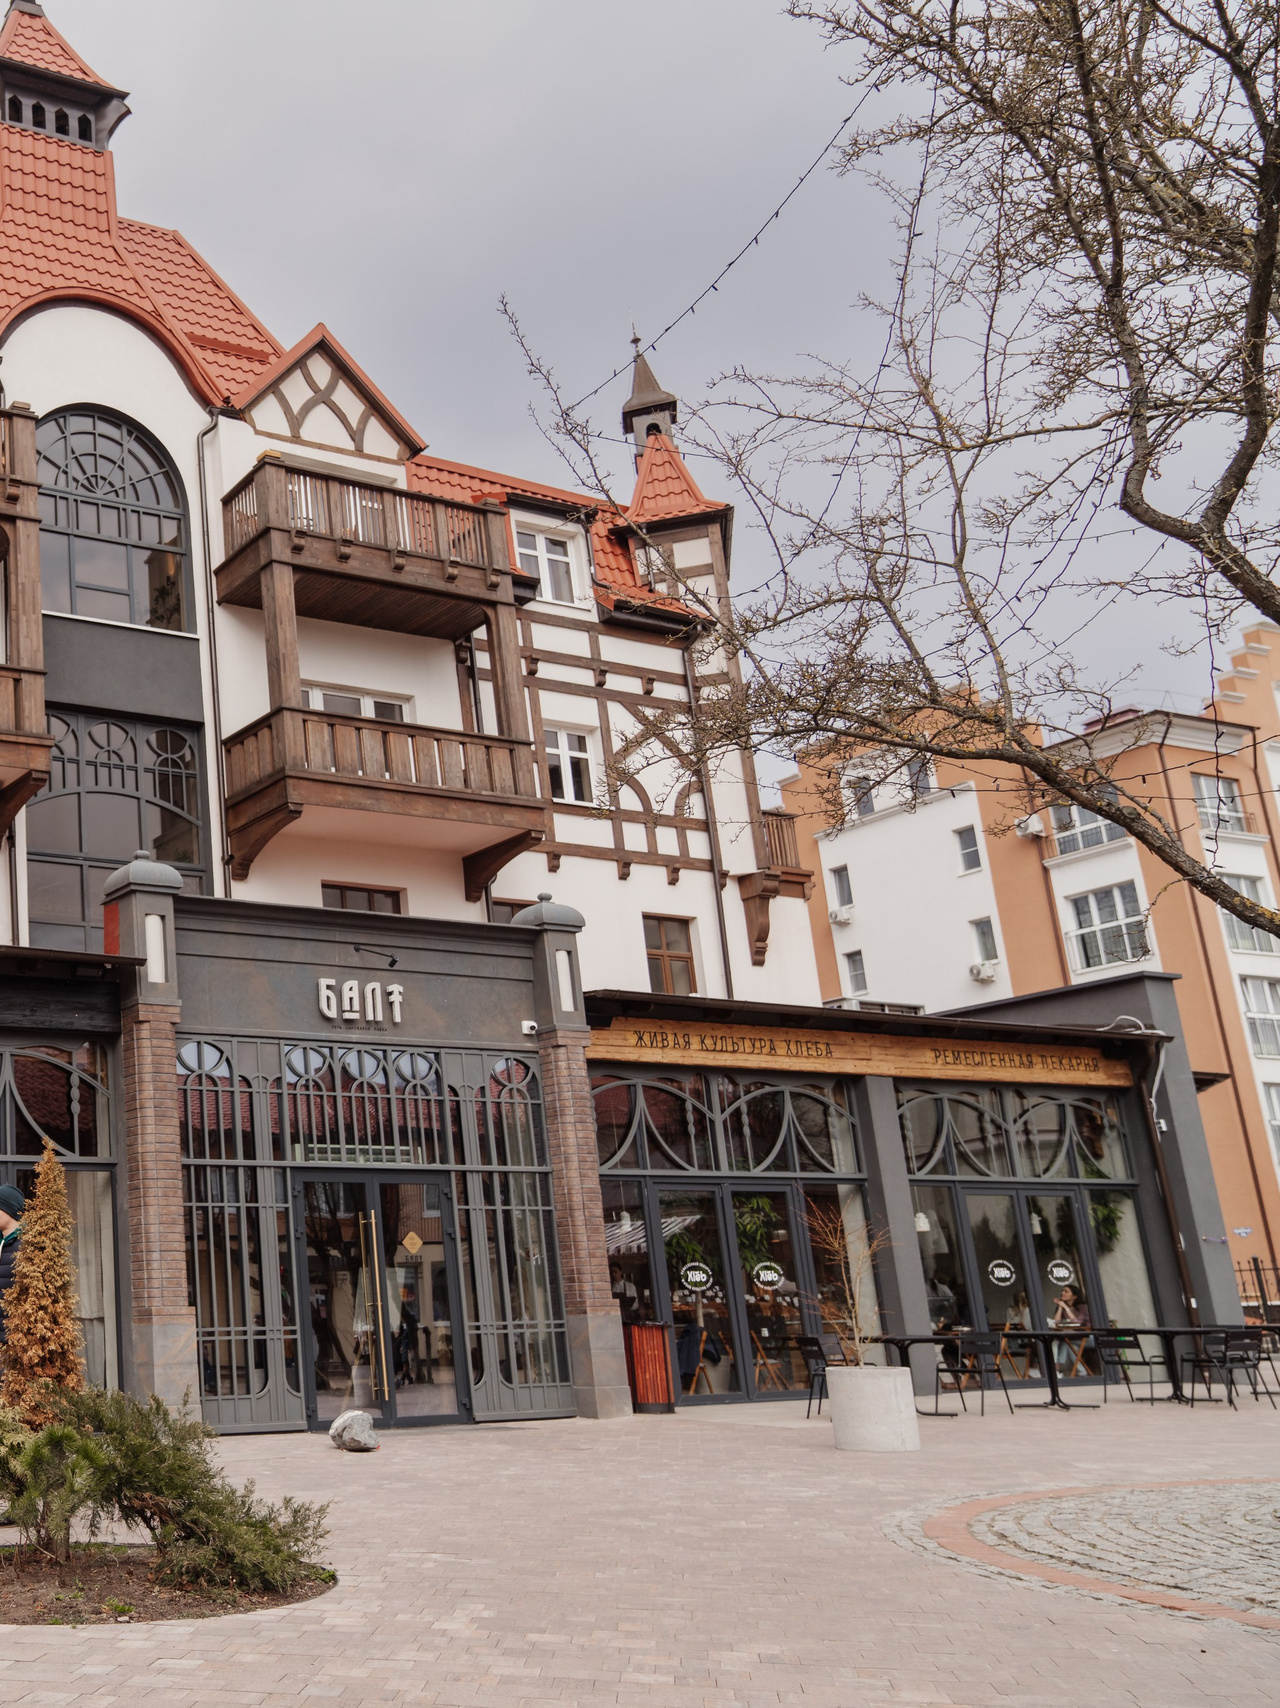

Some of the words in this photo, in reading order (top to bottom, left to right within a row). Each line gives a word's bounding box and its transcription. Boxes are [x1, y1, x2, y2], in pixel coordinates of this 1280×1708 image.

[318, 978, 403, 1023] БАЛТ
[634, 1030, 691, 1049] ЖИВАЯ
[700, 1034, 777, 1055] КУЛЬТУРА
[784, 1039, 833, 1058] ХЛЕБА
[933, 1048, 1034, 1069] РЕМЕСЛЕННАЯ
[1041, 1055, 1099, 1072] ПЕКАРНЯ
